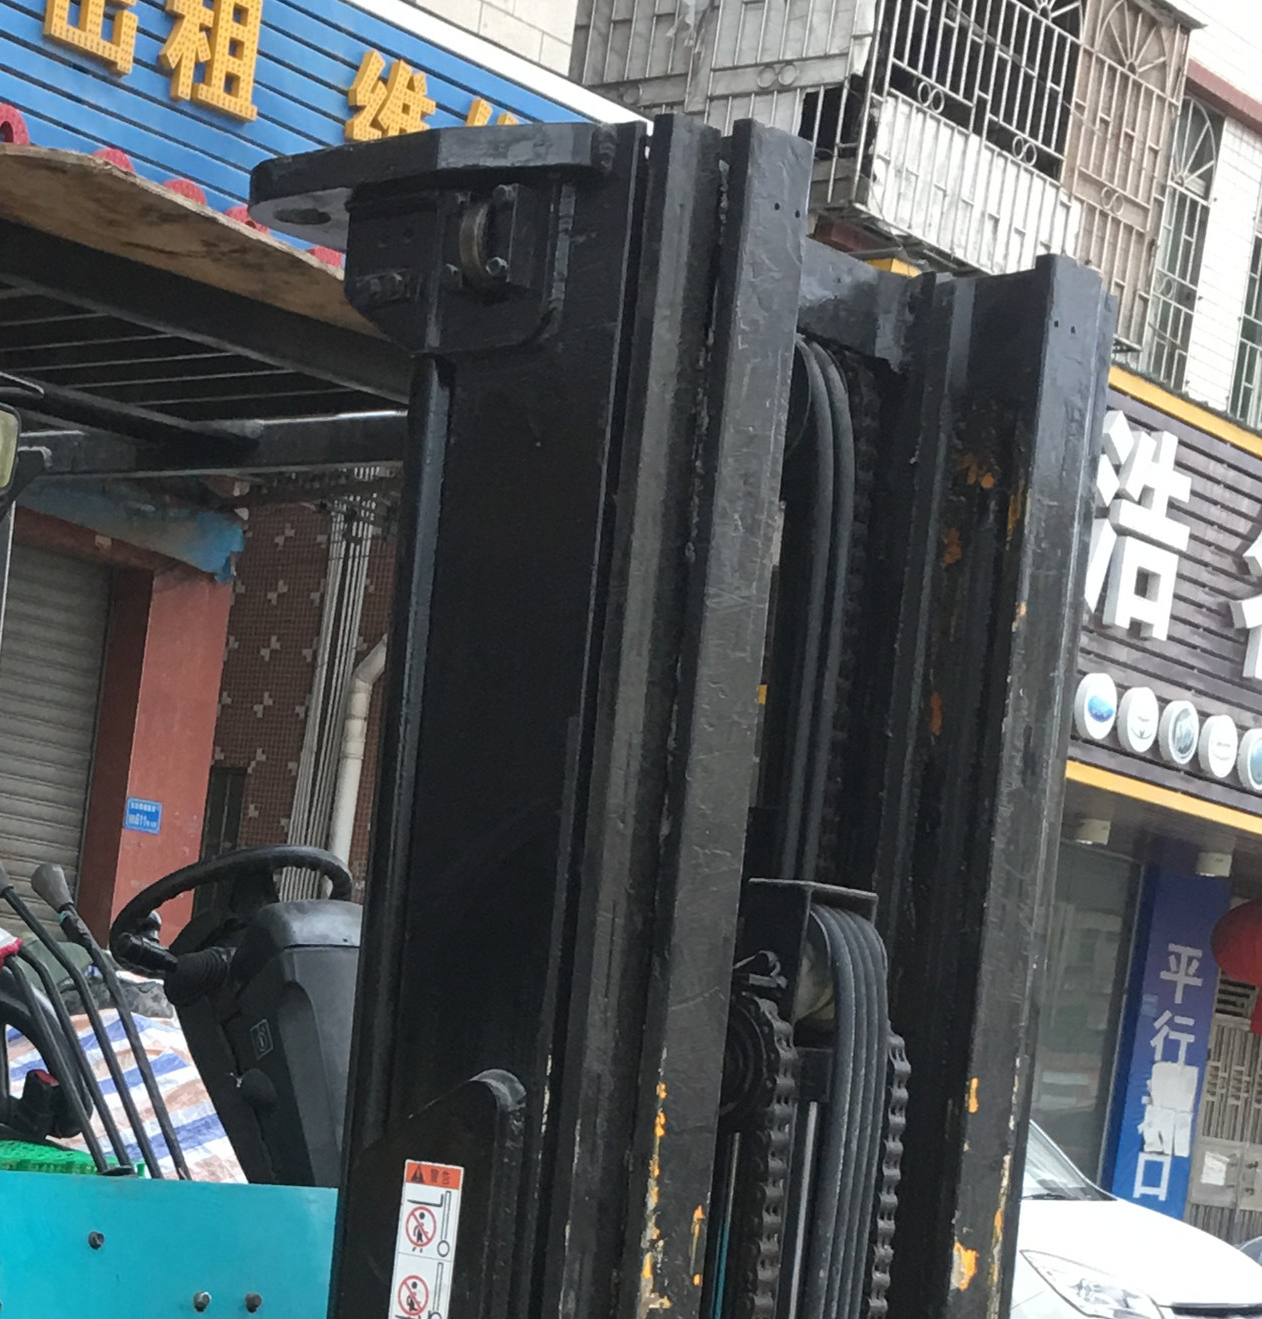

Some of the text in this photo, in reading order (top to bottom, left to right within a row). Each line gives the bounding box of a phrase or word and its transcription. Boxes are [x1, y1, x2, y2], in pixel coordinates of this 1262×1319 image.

[345, 50, 519, 142] 维
[1133, 943, 1202, 1201] 平行口
